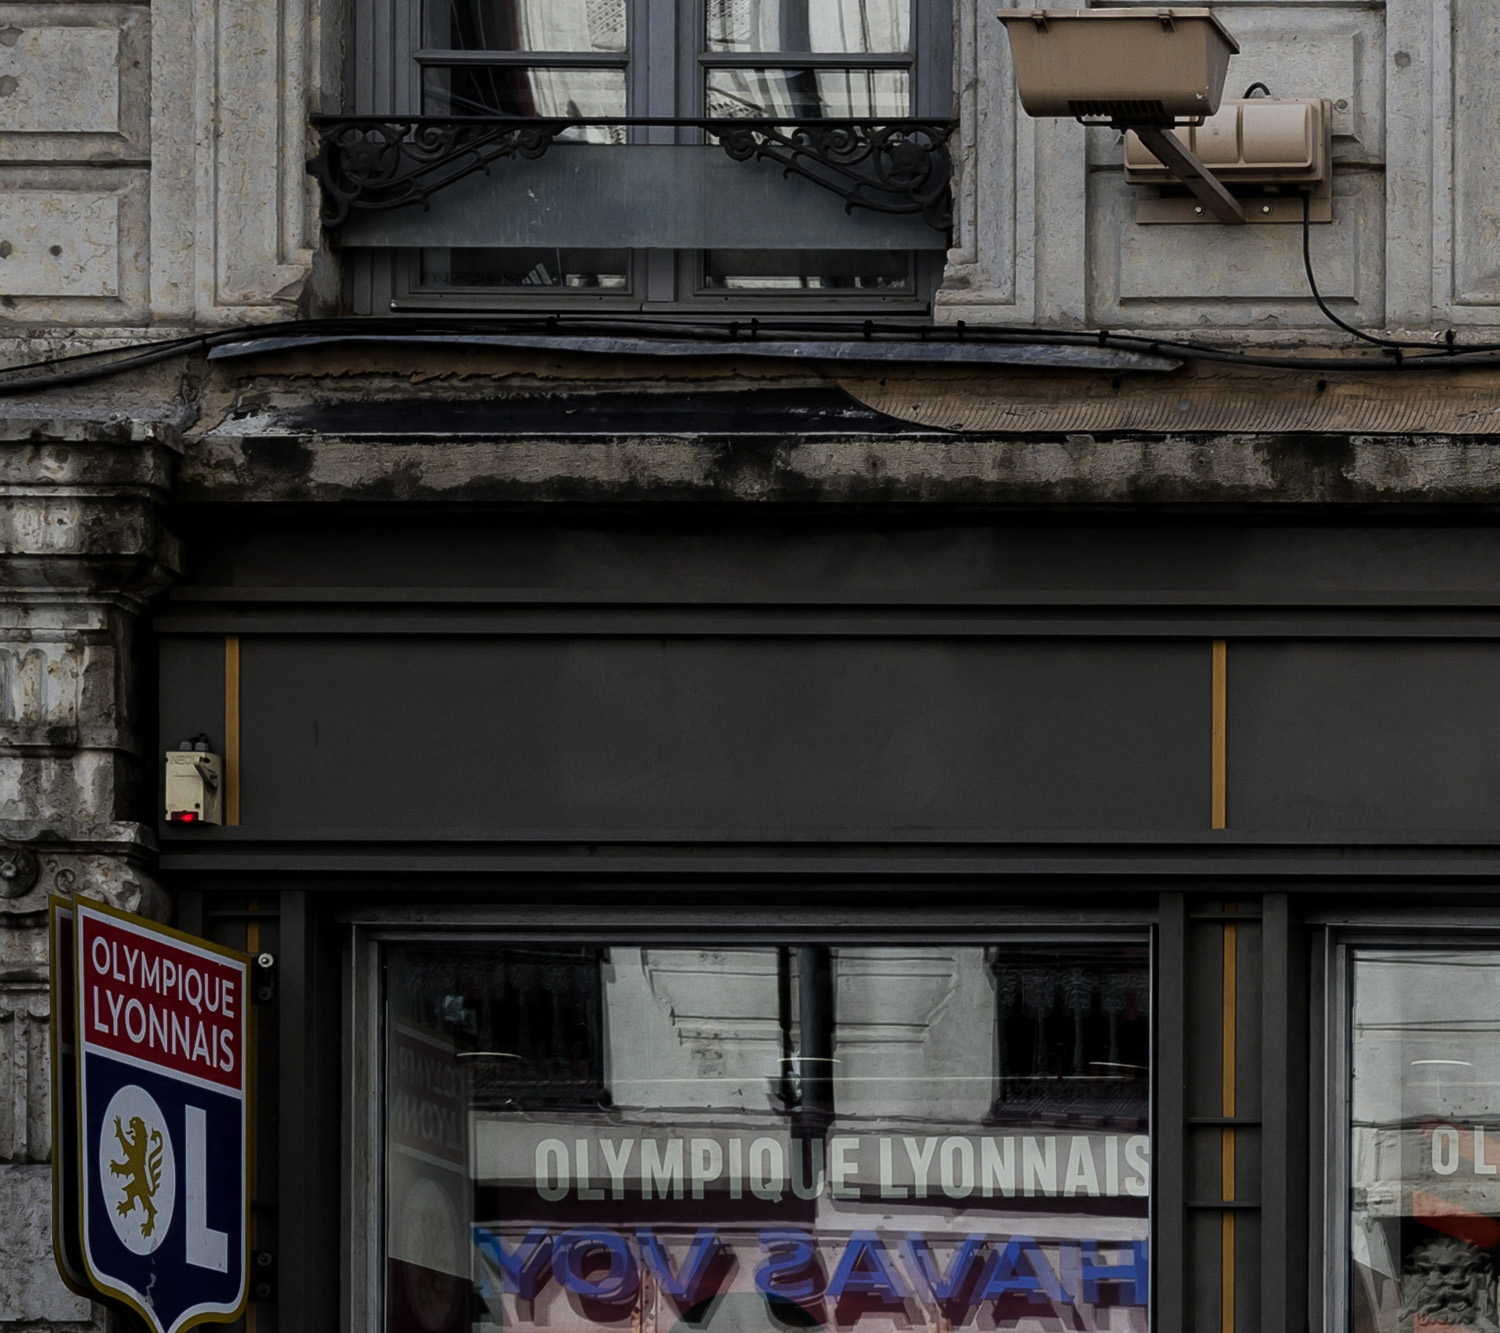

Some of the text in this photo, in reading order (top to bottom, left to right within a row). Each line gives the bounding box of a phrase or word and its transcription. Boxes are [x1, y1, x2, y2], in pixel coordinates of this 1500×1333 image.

[92, 935, 235, 1019] OLYMPIQUE
[93, 985, 235, 1073] LYONNAIS
[99, 1083, 229, 1274] OL
[536, 1135, 1148, 1203] OLYMPIQUE LYONNAIS
